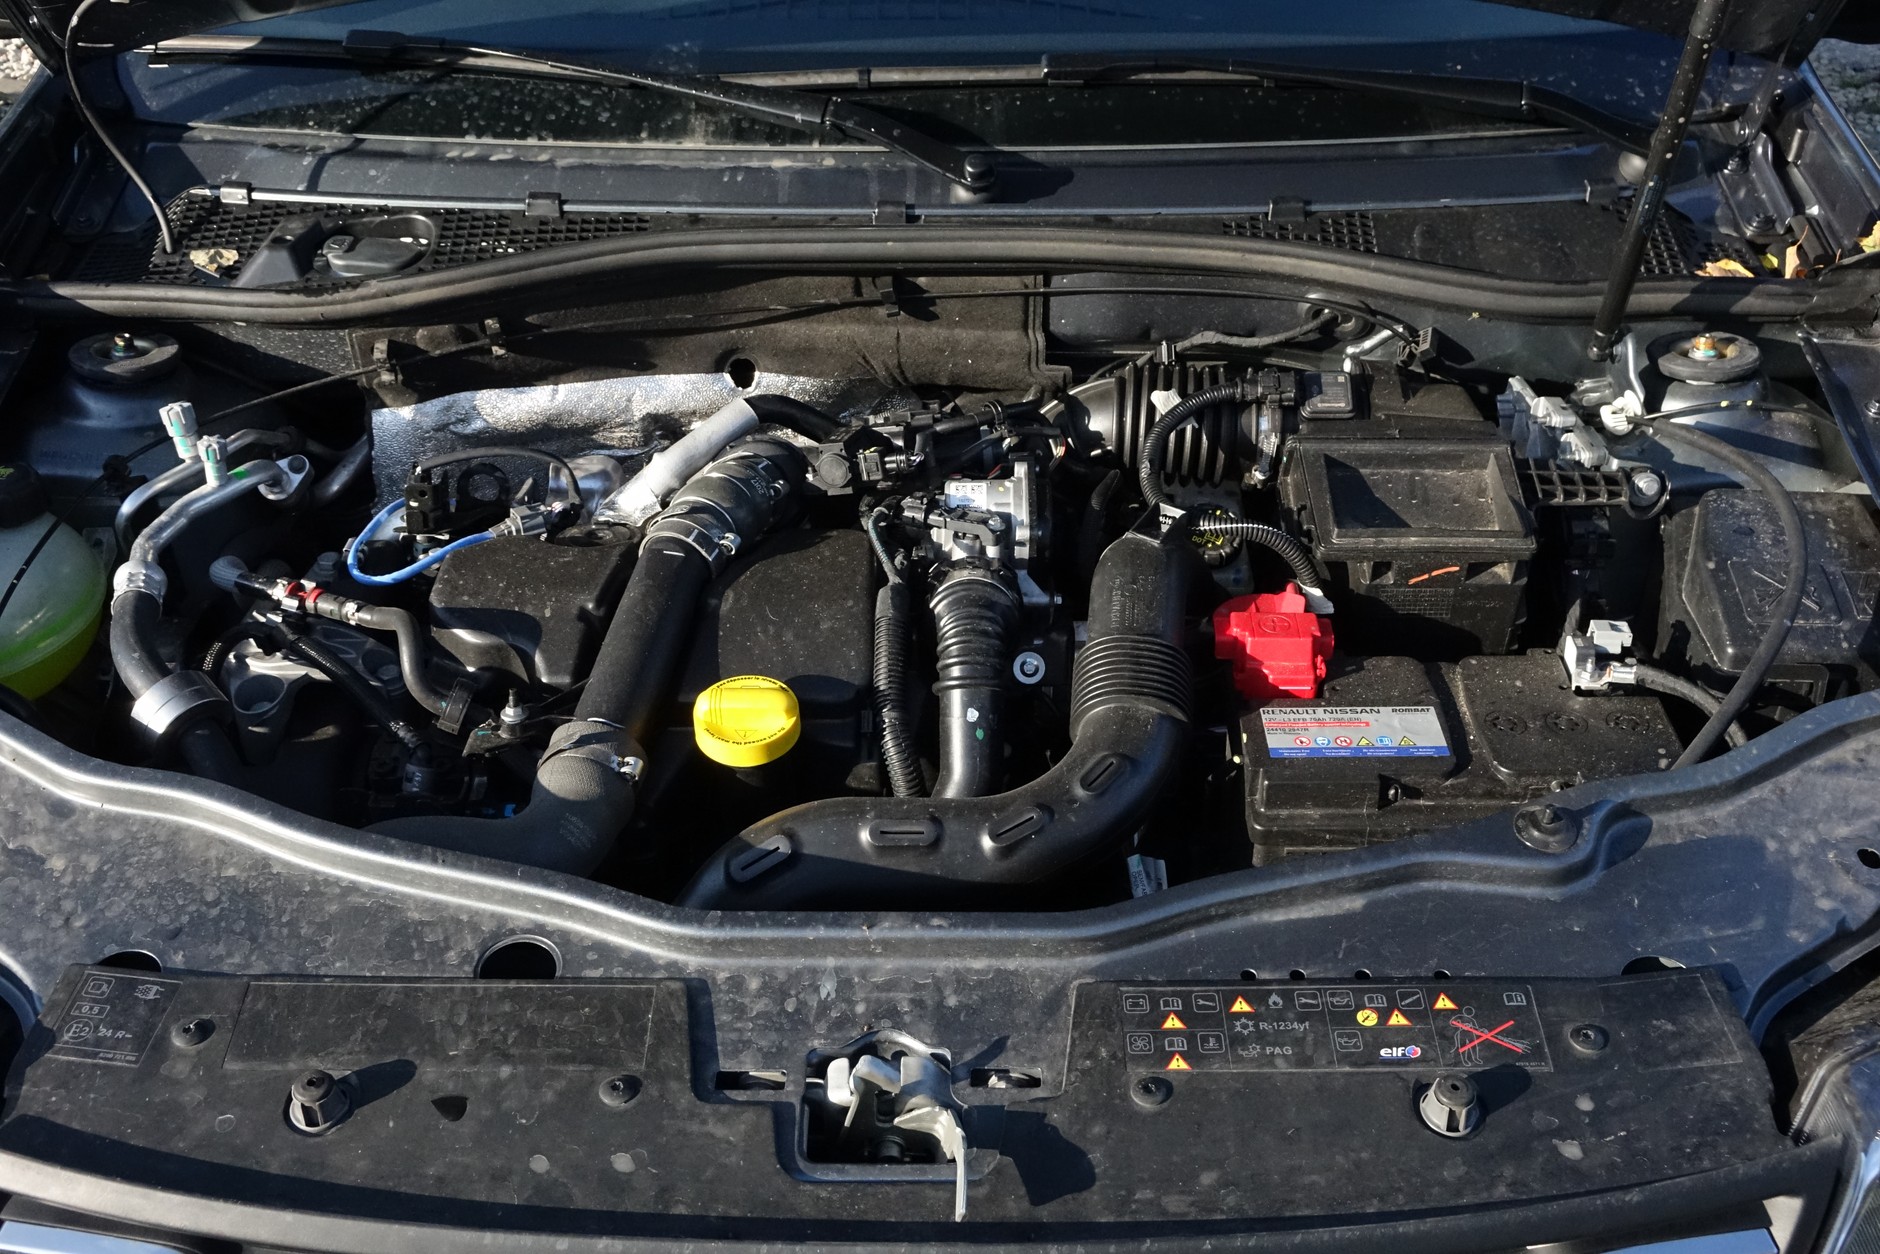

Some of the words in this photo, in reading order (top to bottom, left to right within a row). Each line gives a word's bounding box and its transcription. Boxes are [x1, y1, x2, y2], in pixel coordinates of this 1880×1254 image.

[1192, 535, 1206, 545] DOT
[81, 1005, 100, 1015] 0,5
[67, 1023, 90, 1037] E2
[1259, 1022, 1310, 1032] R-1234yf
[1266, 1046, 1292, 1055] PAG
[1379, 1046, 1406, 1057] elf
